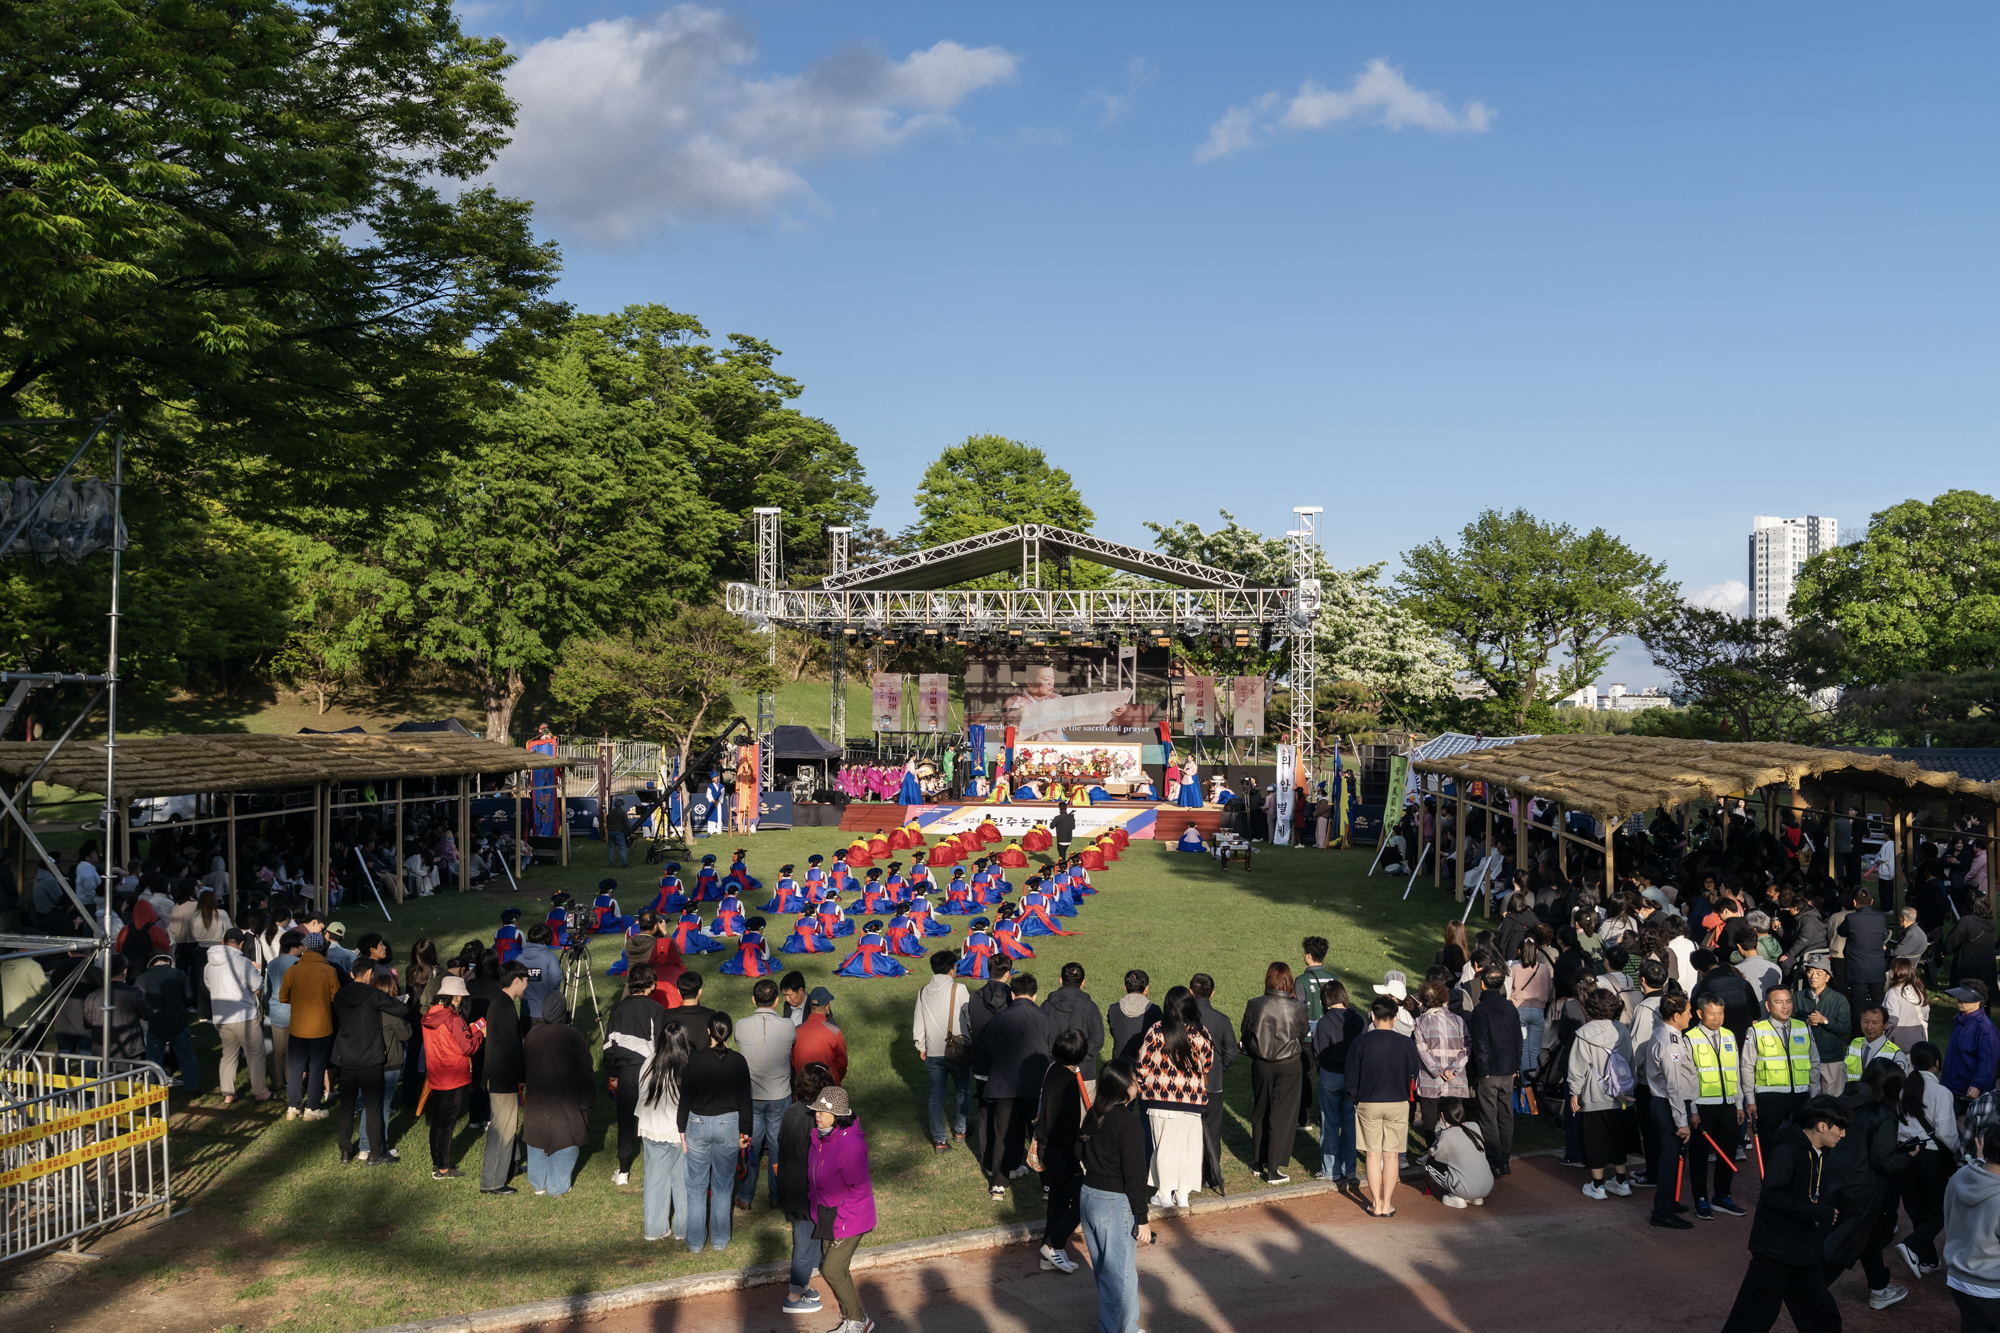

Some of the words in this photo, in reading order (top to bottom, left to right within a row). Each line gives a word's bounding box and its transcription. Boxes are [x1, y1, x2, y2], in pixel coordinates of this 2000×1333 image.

[929, 678, 938, 714] 의암별제
[1196, 680, 1204, 717] 의암별제
[1019, 724, 1043, 733] please
[1123, 726, 1151, 734] prayer
[990, 816, 1054, 827] 진주논개
[8, 1131, 32, 1144] 출입금지
[43, 1124, 54, 1134] 위험
[58, 1116, 80, 1130] 출입금지
[90, 1110, 101, 1120] 위험
[104, 1103, 126, 1116] 출입금지
[135, 1097, 145, 1106] 위험
[148, 1089, 168, 1102] 출입금지
[32, 1164, 43, 1174] 위험
[47, 1155, 70, 1169] 출입금지
[81, 1149, 92, 1158] 위험
[95, 1140, 117, 1154] 출입금지
[127, 1134, 137, 1143] 위험
[140, 1126, 161, 1139] 출입금지
